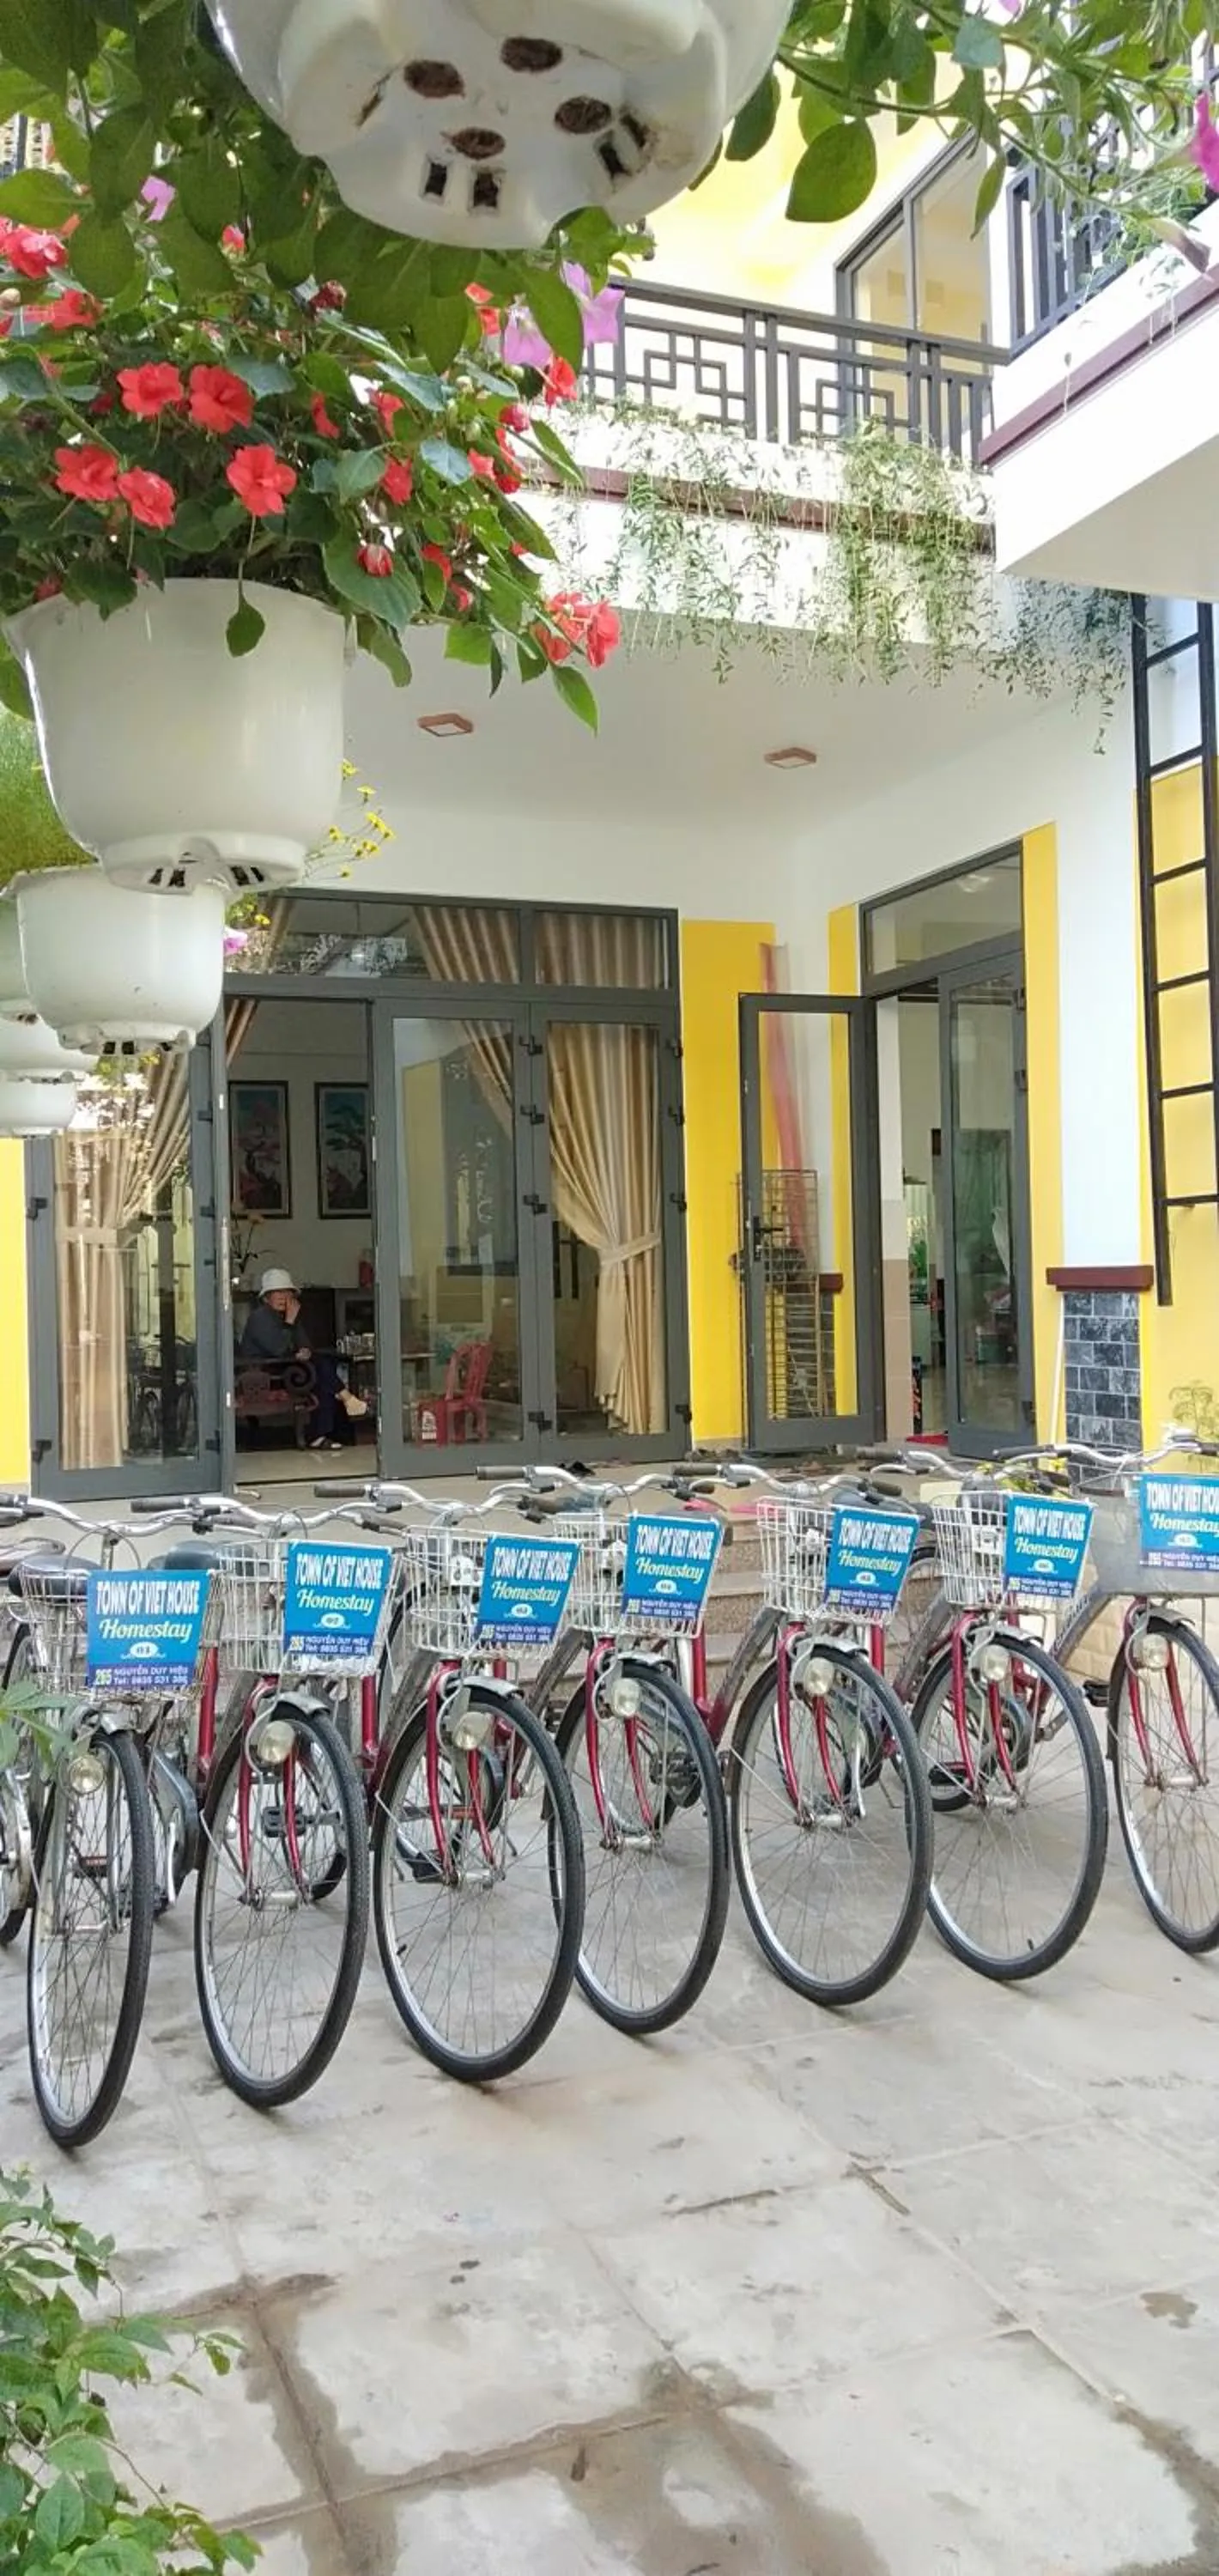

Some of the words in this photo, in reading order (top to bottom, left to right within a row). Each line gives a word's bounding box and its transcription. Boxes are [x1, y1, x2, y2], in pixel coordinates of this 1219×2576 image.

[1147, 1482, 1172, 1510] TOWN
[1172, 1484, 1185, 1511] OF
[1185, 1485, 1202, 1512] VIET
[1202, 1485, 1219, 1515] HOU
[838, 1518, 863, 1546] TOWN
[861, 1520, 876, 1550] OF
[872, 1522, 890, 1551] VIET
[888, 1525, 913, 1553] HOUSE
[1014, 1506, 1038, 1535] TOWN
[1036, 1508, 1048, 1537] OF
[1046, 1510, 1064, 1539] VIET
[1061, 1512, 1086, 1541] HOUSE
[635, 1524, 661, 1554] TOWN
[659, 1526, 674, 1556] OF
[671, 1528, 689, 1558] VIET
[687, 1530, 714, 1560] HOUSE
[1014, 1537, 1078, 1564] Homestay
[295, 1552, 324, 1586] TOWN
[322, 1554, 337, 1587] OF
[336, 1555, 356, 1588] VIET
[354, 1557, 384, 1590] HOUSE
[491, 1546, 518, 1578] TOWN
[516, 1548, 531, 1580] OF
[528, 1549, 549, 1580] VIET
[544, 1551, 573, 1583] HOUSE
[636, 1557, 705, 1584] Homestay
[838, 1549, 902, 1577] Homestay
[96, 1581, 128, 1614] TOWN
[128, 1581, 144, 1614] OF
[145, 1581, 167, 1614] VIET
[167, 1580, 200, 1614] HOUSE
[296, 1588, 374, 1617] Homestay
[491, 1581, 561, 1607] Homestay
[99, 1618, 192, 1643] Homestay
[150, 1667, 167, 1675] DUY
